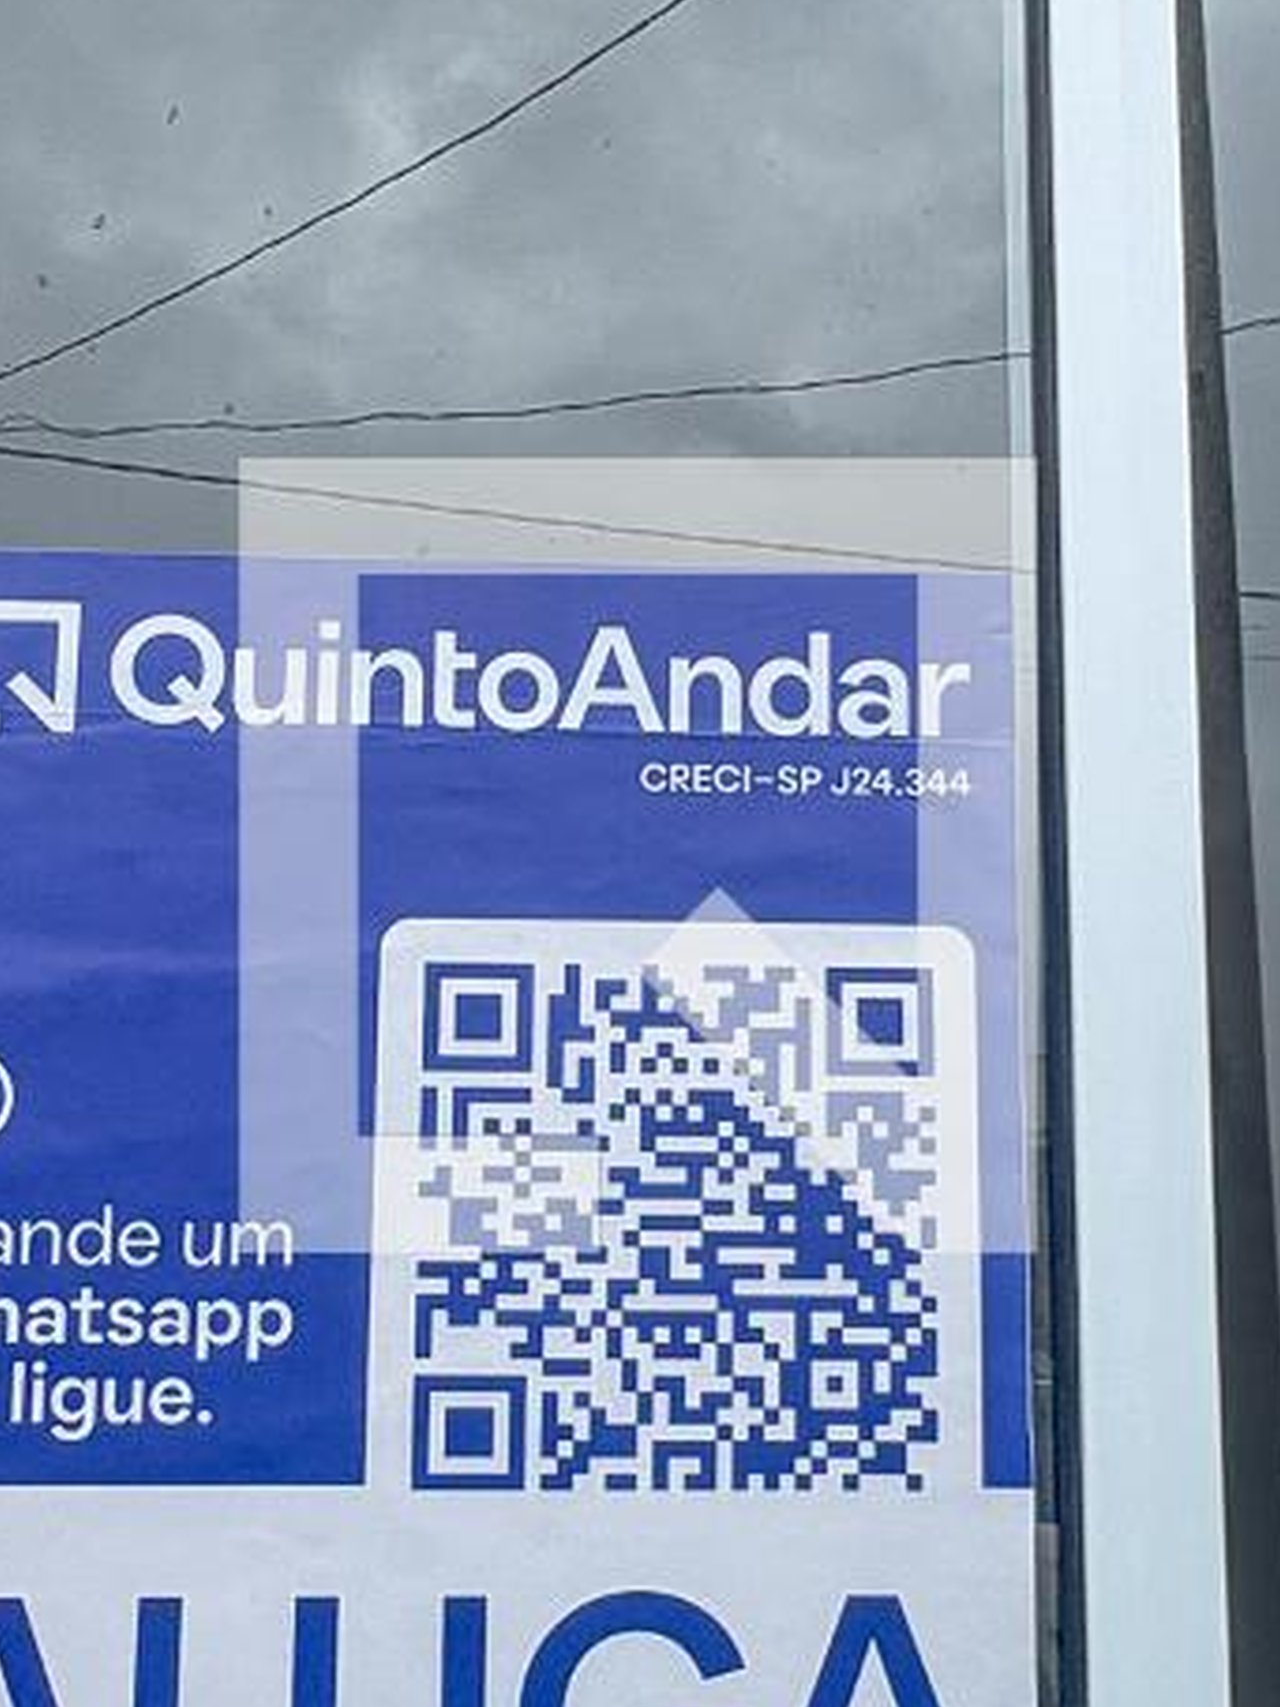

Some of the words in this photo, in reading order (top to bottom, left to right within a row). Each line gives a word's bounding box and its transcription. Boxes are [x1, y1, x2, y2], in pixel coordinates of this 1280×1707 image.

[110, 613, 971, 737] QuintoAndar
[640, 763, 823, 794] CRECI-SP
[830, 767, 971, 797] J24.344
[184, 1220, 293, 1266] um
[10, 1361, 213, 1441] ligue.
